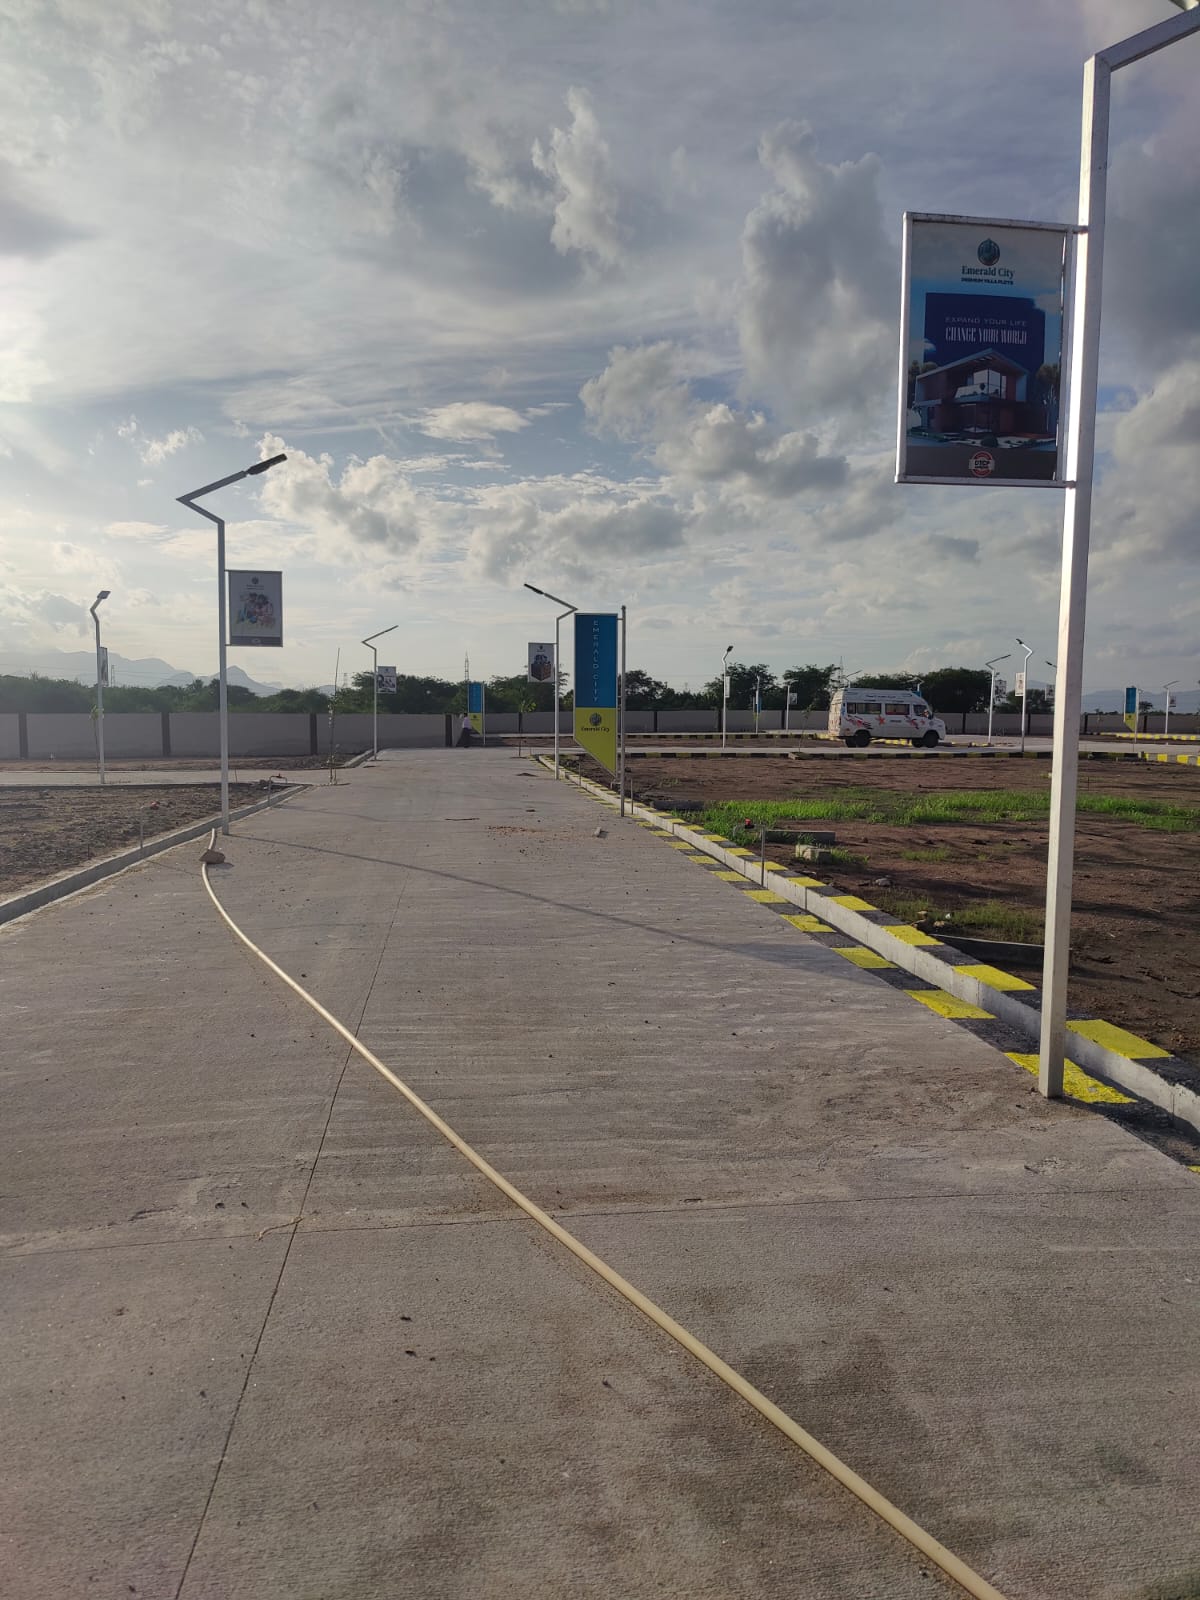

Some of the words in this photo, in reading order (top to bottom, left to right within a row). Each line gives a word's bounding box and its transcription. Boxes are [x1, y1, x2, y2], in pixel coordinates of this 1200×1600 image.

[961, 265, 996, 276] Emerald
[998, 267, 1014, 280] City
[945, 316, 981, 324] EXPAND
[1009, 319, 1027, 327] LIFE
[945, 326, 977, 343] CHANGE
[978, 327, 999, 344] YOUR
[1000, 328, 1027, 345] WORLD
[592, 620, 600, 669] EMERALD
[592, 673, 600, 702] CITY
